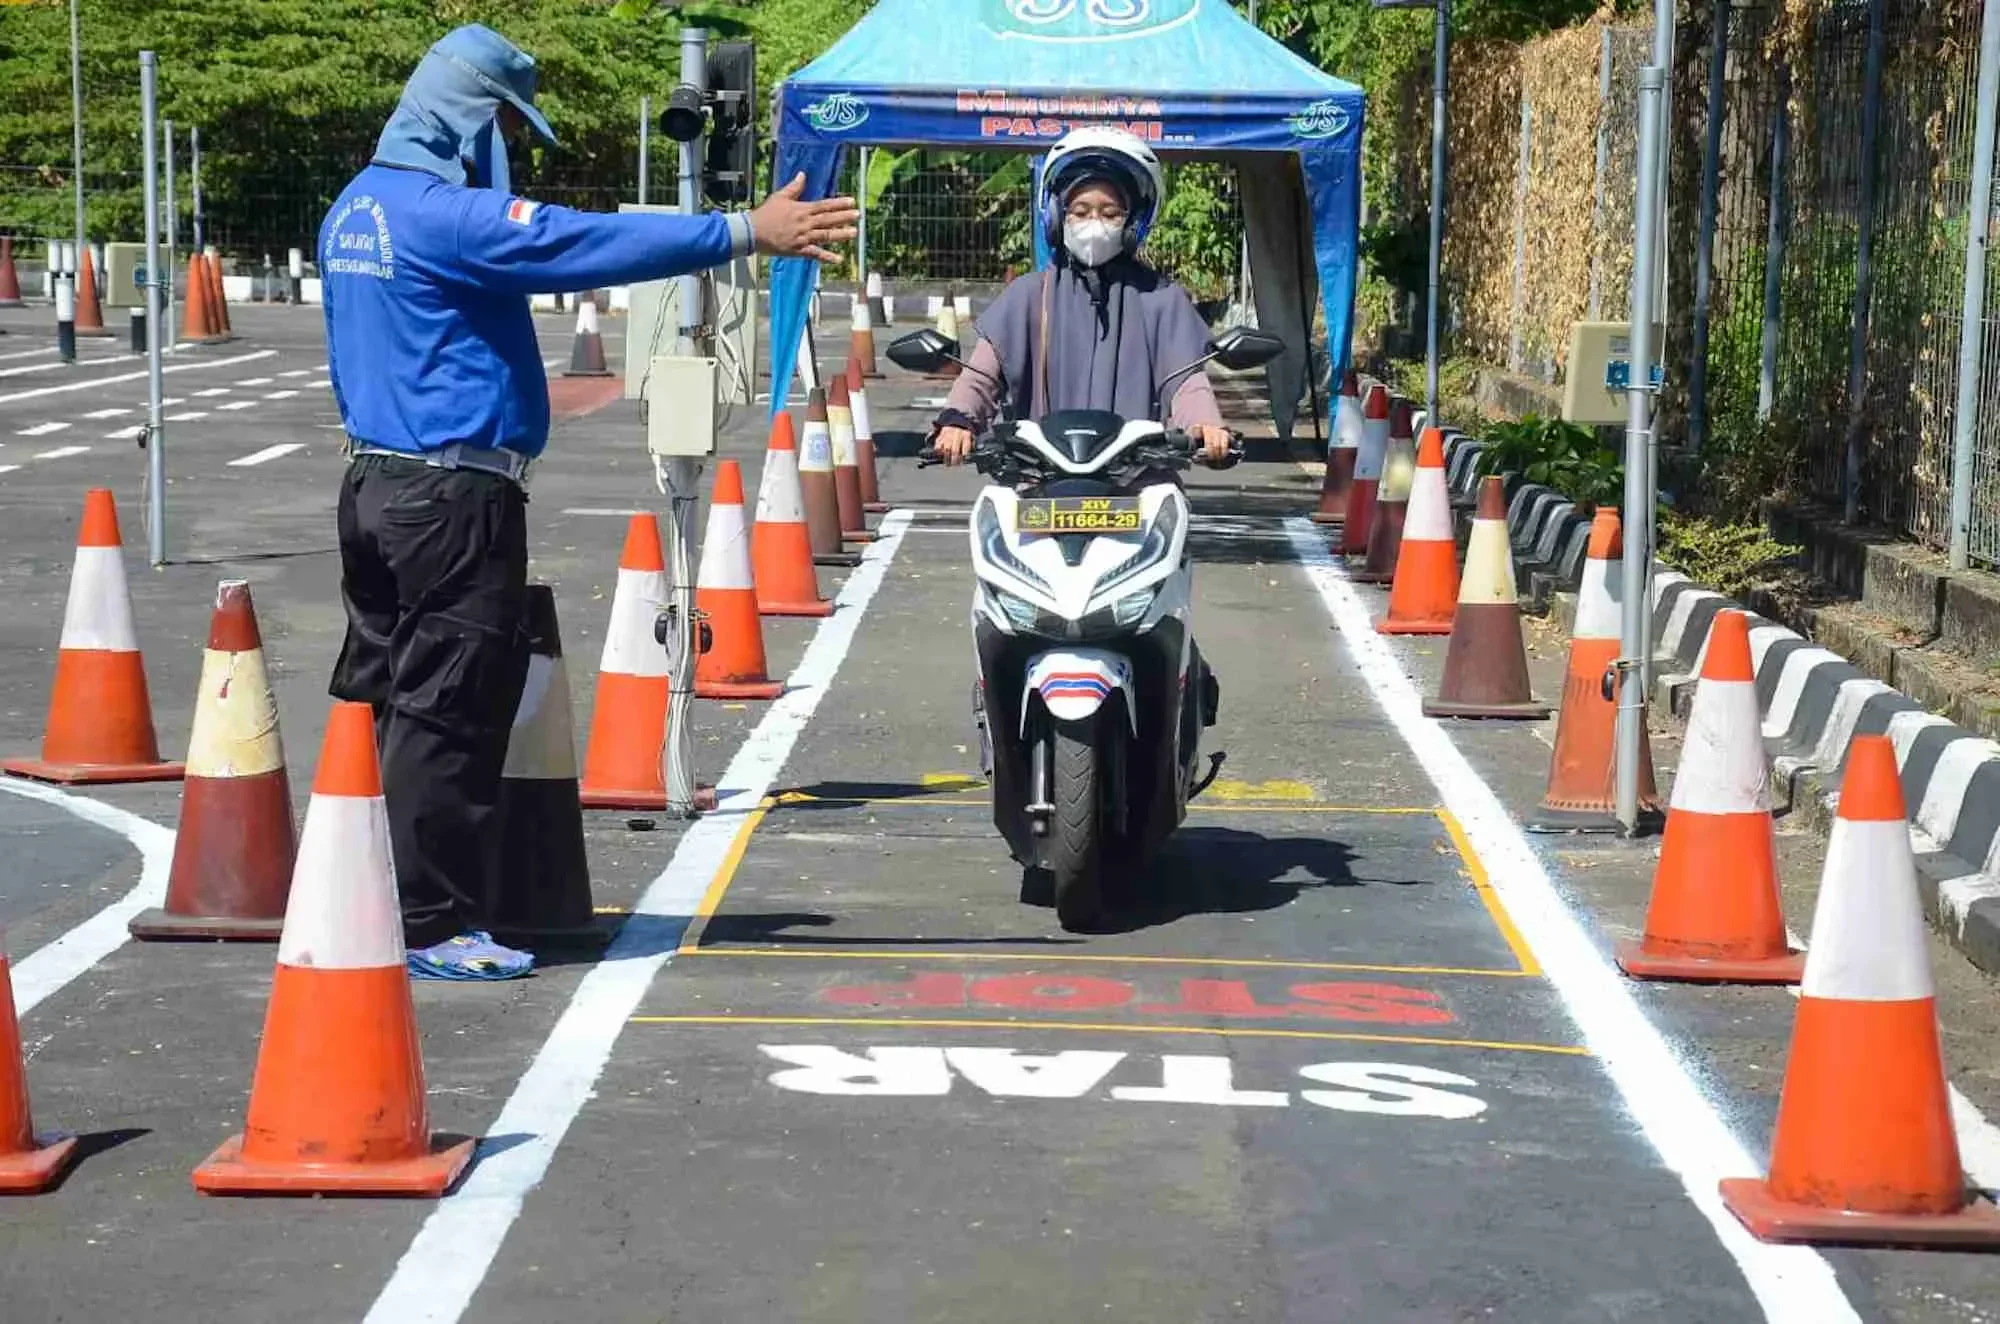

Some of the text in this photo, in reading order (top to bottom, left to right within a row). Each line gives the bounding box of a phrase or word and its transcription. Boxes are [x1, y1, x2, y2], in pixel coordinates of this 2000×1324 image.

[1055, 512, 1138, 528] 11664-29
[1081, 500, 1111, 511] XIV
[820, 972, 1454, 1025] STOP
[757, 1043, 1488, 1119] STAR
